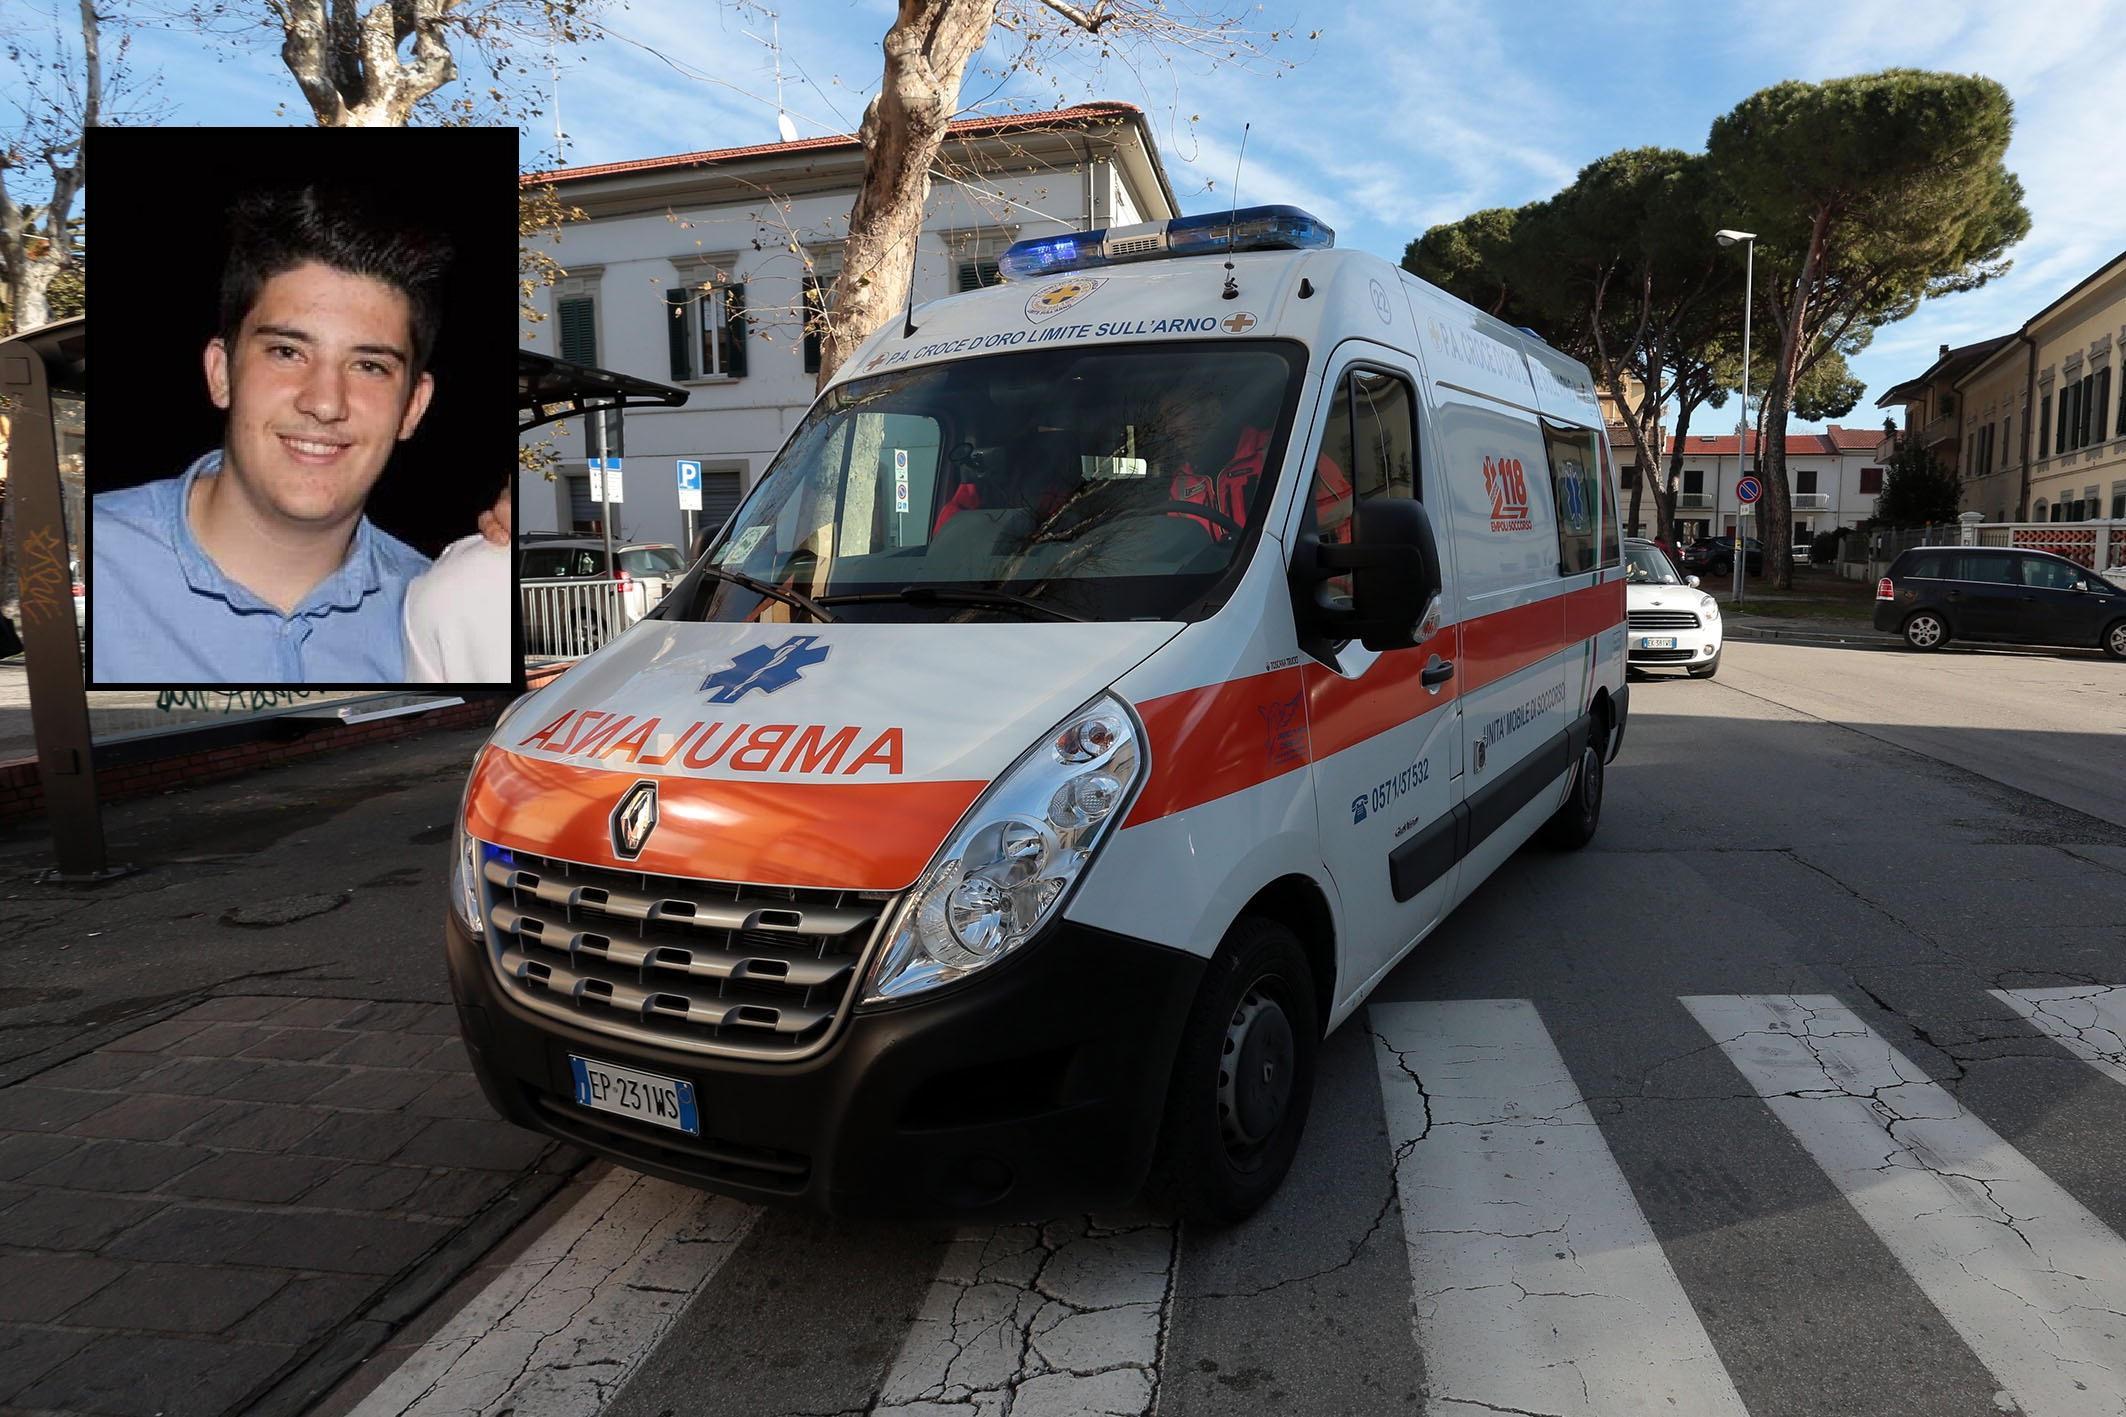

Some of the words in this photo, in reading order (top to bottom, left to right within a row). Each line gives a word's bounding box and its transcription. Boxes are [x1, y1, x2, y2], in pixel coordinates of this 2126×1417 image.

[885, 352, 909, 365] P.A.
[914, 338, 970, 359] CROCE
[969, 331, 1026, 351] D'ORO
[1027, 324, 1093, 343] LIMITE
[1095, 317, 1217, 337] SULL'ARNO
[681, 463, 696, 487] P
[1498, 457, 1527, 506] 118
[1506, 702, 1530, 736] MOBILE
[1530, 698, 1537, 721] DI
[1372, 758, 1429, 813] 0571/57532
